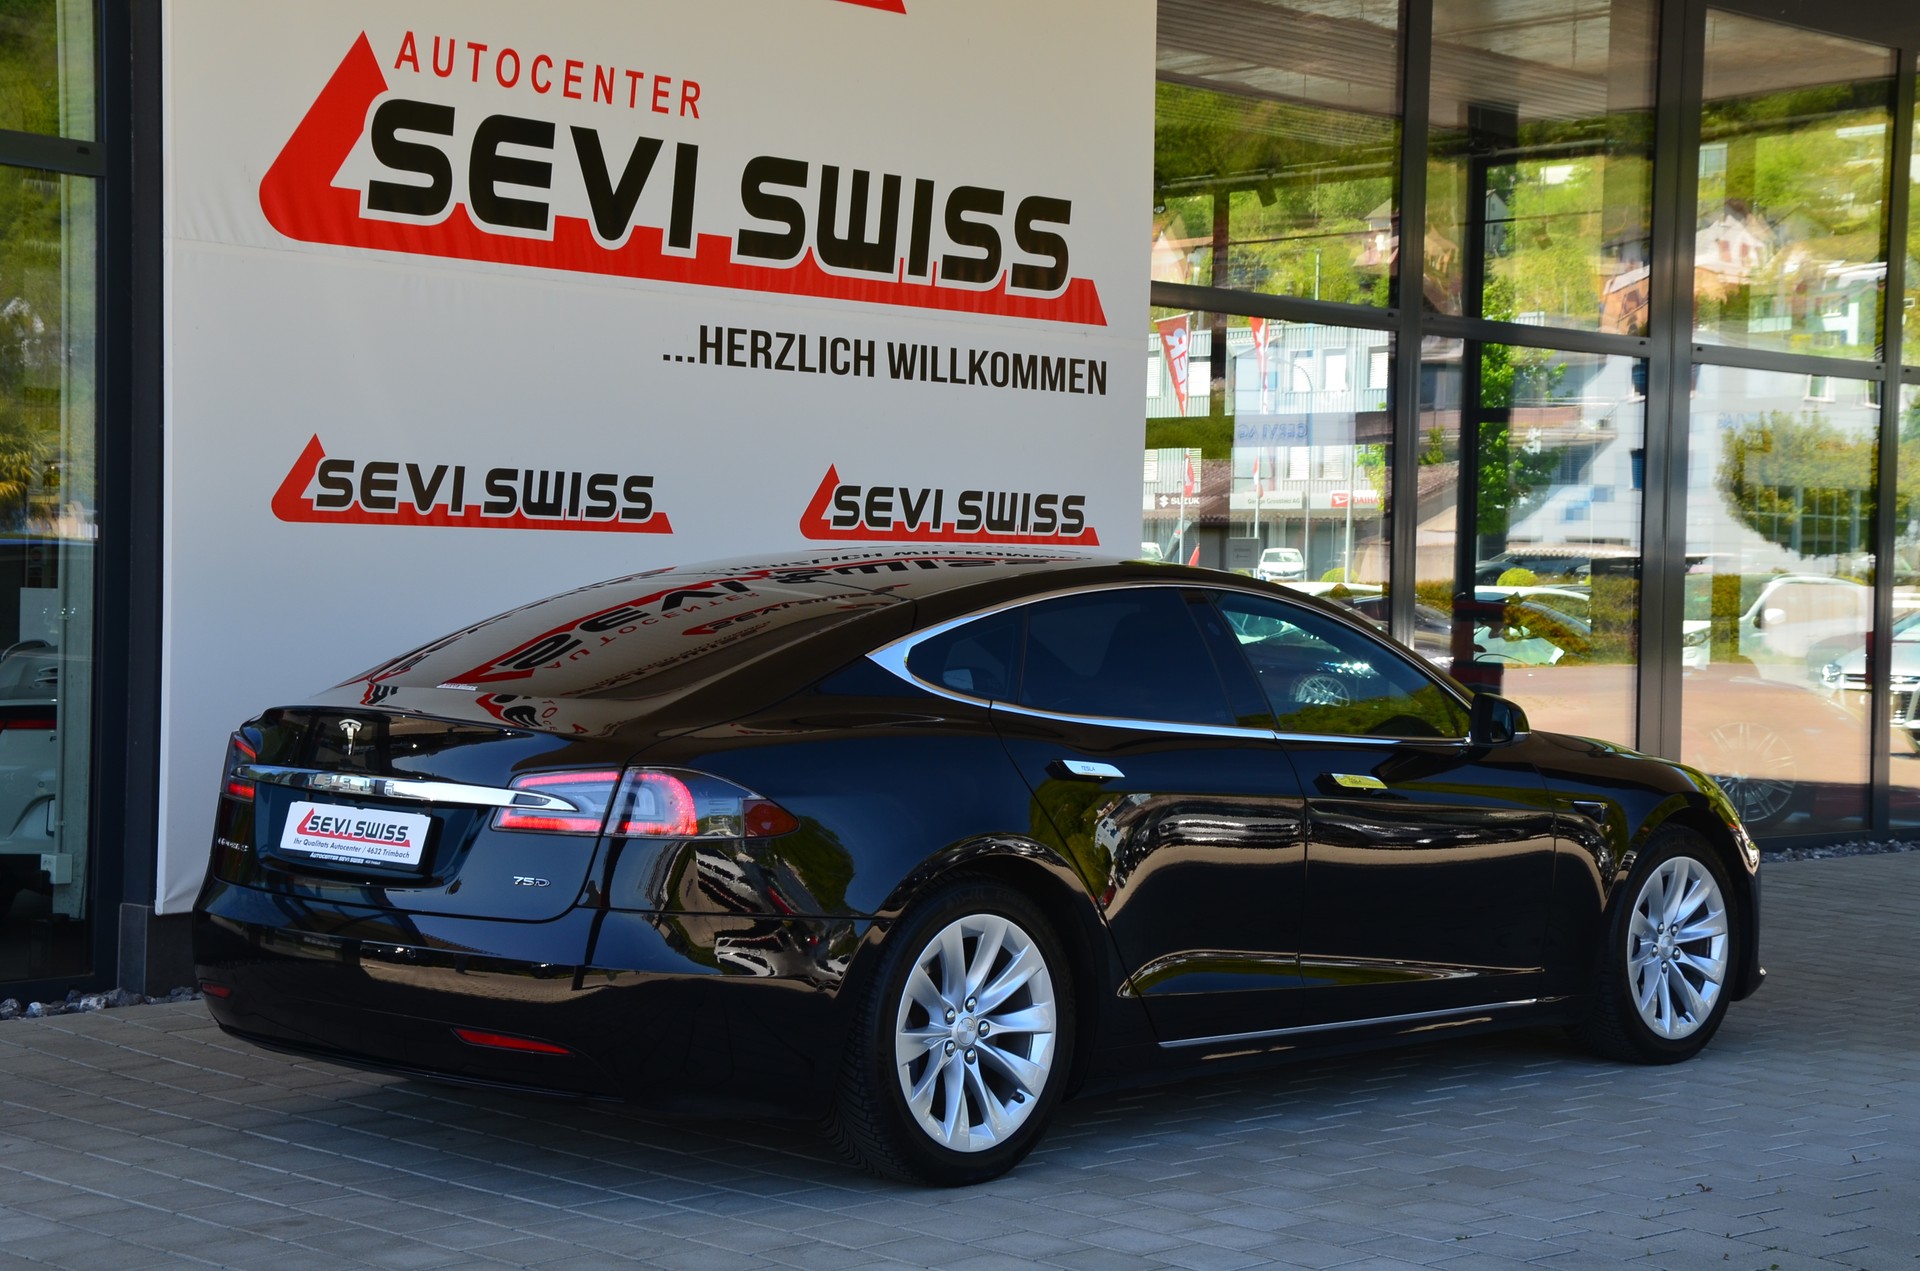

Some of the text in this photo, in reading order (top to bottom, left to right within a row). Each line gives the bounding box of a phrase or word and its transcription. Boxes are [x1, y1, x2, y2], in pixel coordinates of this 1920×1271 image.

[394, 31, 700, 119] AUTOCENTER
[367, 98, 1072, 291] SEVI SWISS
[887, 341, 1108, 396] WILLKOMMEN
[316, 458, 654, 520] SEVI SWISS
[832, 485, 1086, 534] SEVI SWISS
[308, 815, 409, 842] SEVI SWISS
[330, 842, 362, 853] Autocenter
[367, 847, 382, 855] 4632
[382, 848, 410, 859] Trimbach
[513, 876, 551, 887] 75D
